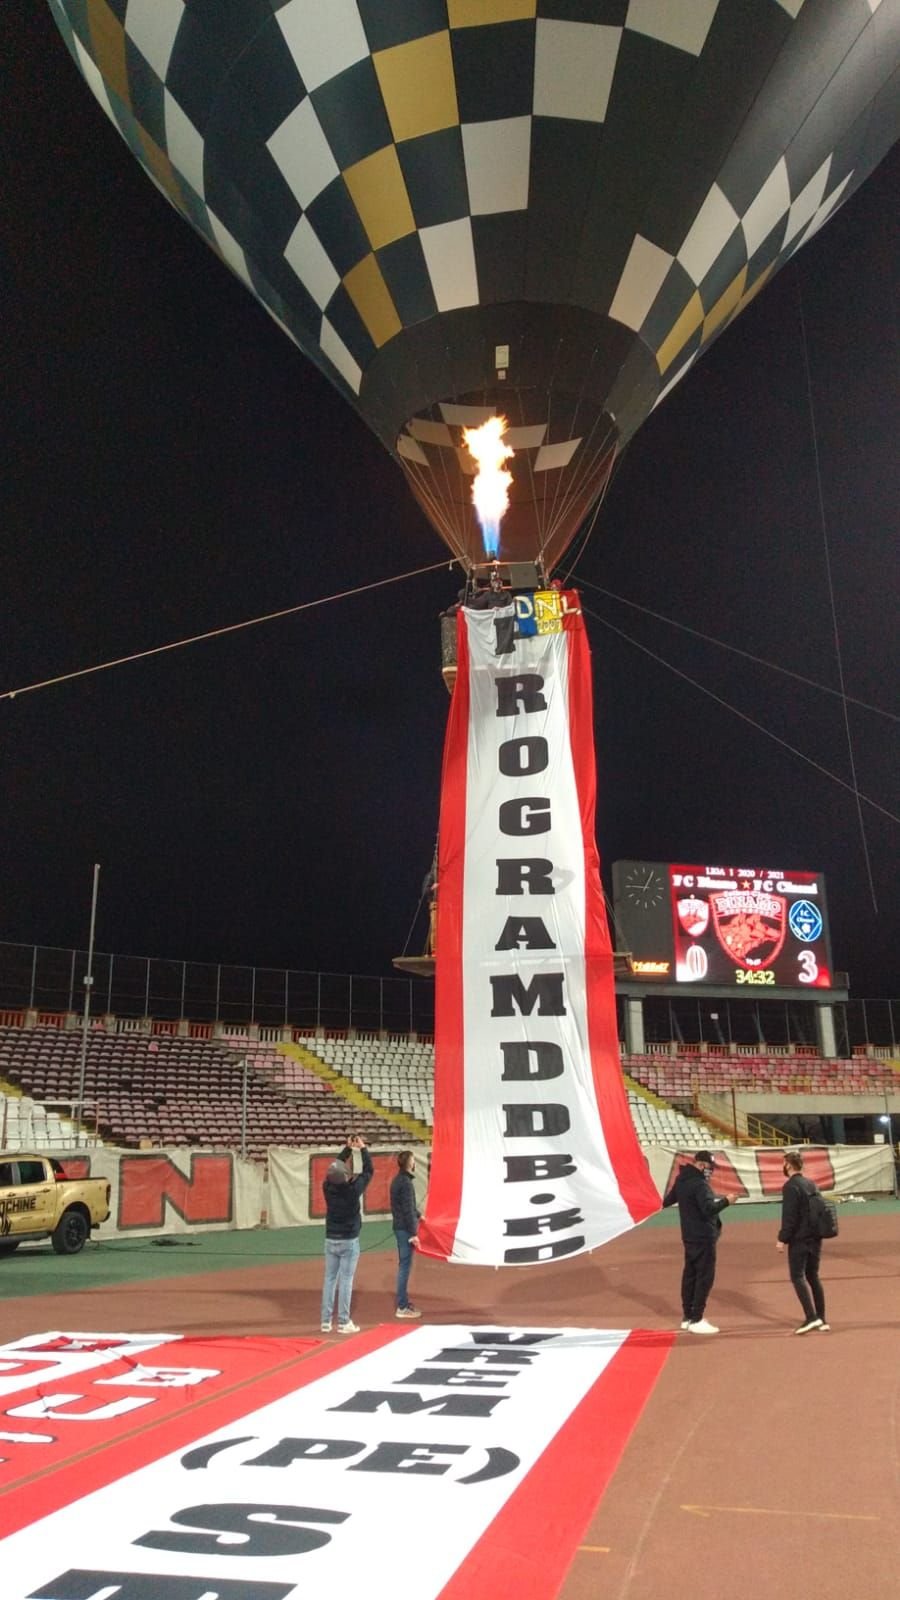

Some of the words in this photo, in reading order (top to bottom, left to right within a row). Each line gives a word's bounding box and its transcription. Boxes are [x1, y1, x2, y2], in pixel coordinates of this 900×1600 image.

[735, 968, 776, 985] 34:32
[797, 949, 819, 984] 3
[180, 1435, 520, 1485] (PE)
